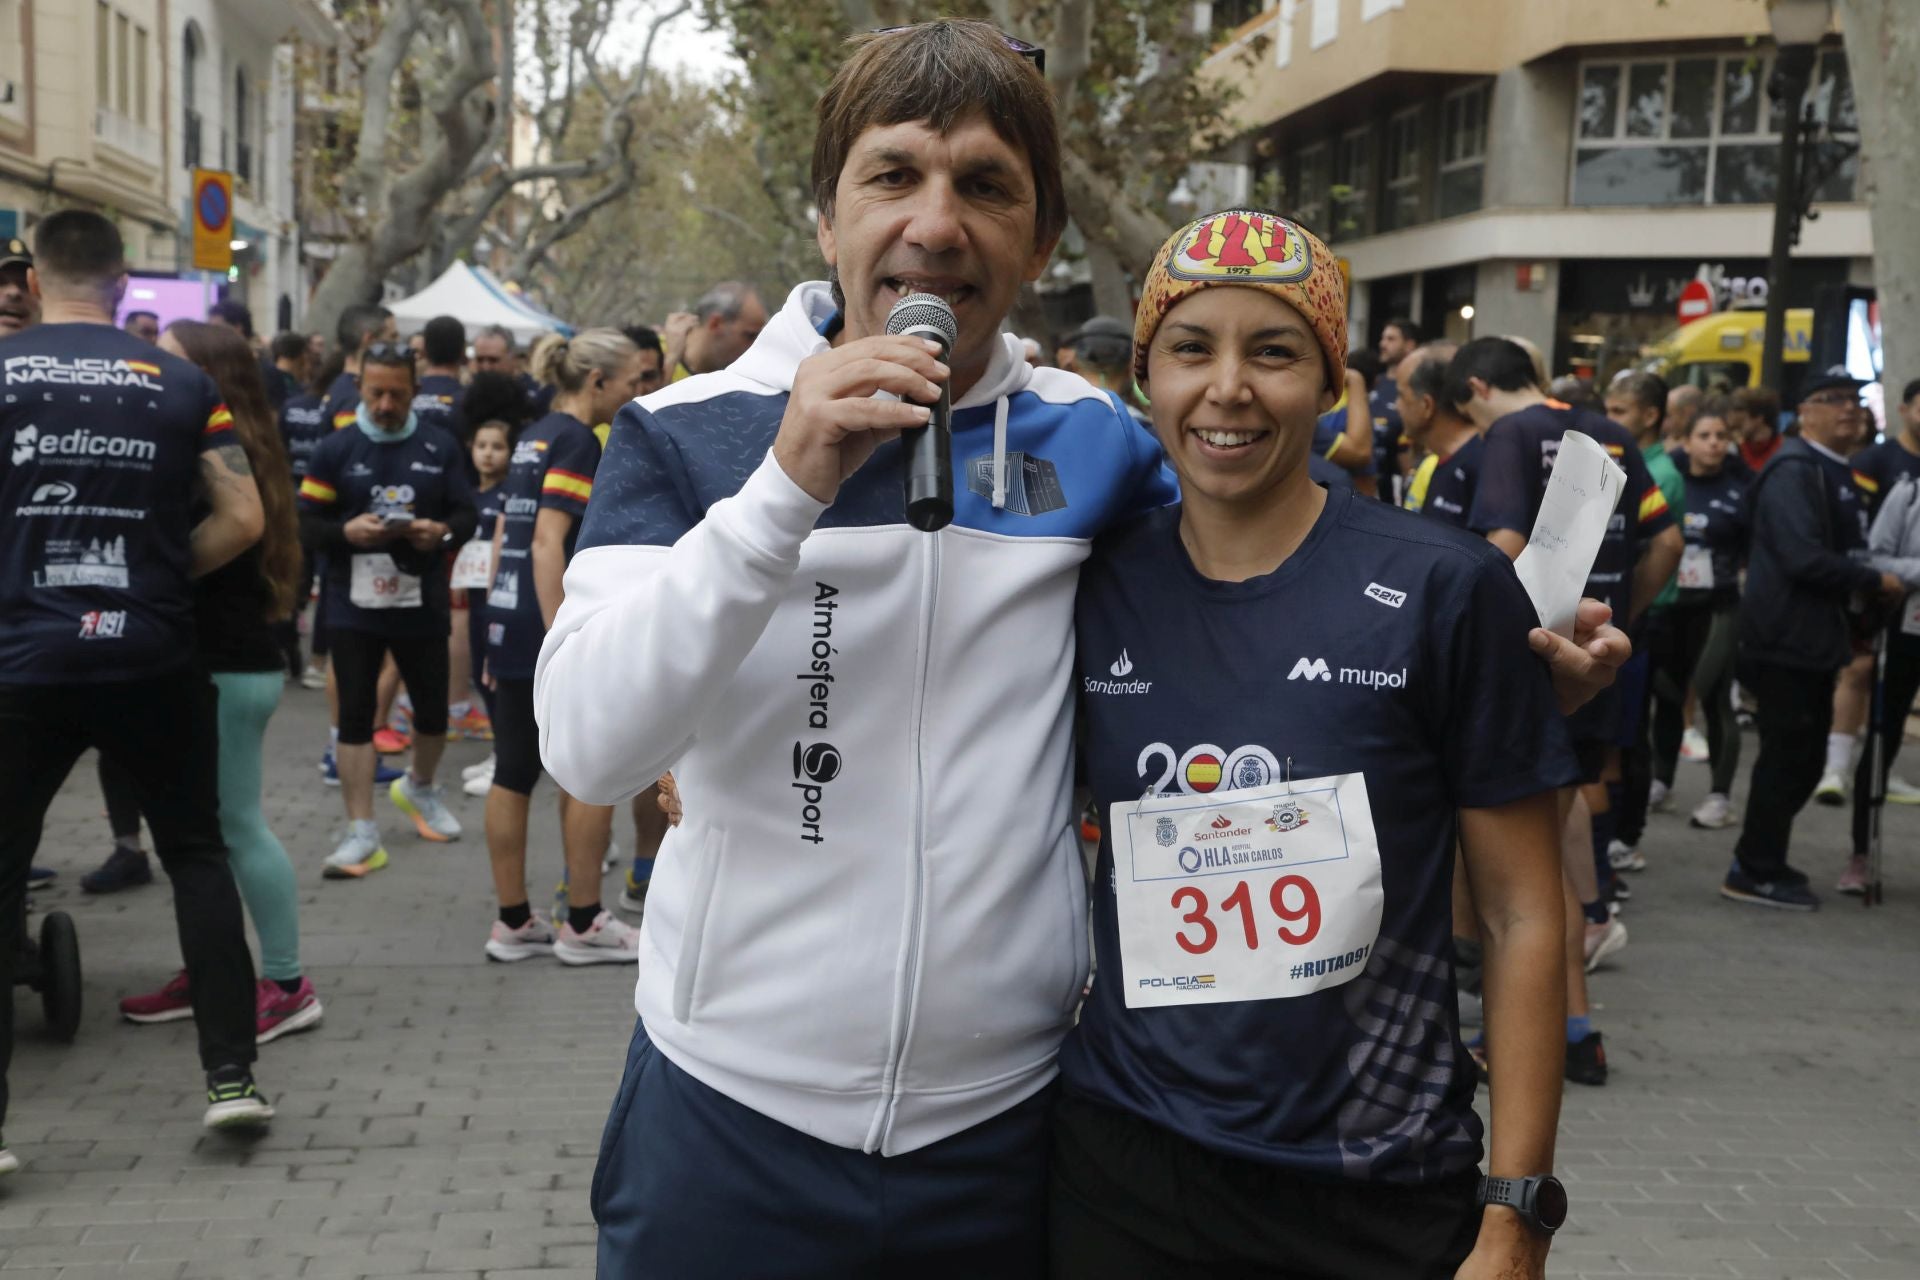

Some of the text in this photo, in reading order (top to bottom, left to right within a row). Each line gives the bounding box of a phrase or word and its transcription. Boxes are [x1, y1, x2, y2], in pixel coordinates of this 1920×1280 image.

[1226, 267, 1252, 275] 1975
[4, 355, 132, 372] POLICIA
[5, 368, 164, 391] NACIONAL
[38, 428, 157, 460] edicom
[15, 505, 146, 520] POWER ELECTRONICS
[1368, 587, 1404, 605] 42K
[796, 581, 840, 729] Atmósfera
[1084, 676, 1153, 695] Santander
[1339, 667, 1407, 691] mupol
[1136, 742, 1281, 800] 200
[1273, 800, 1297, 810] mupol
[1194, 827, 1253, 842] Santander
[1203, 846, 1232, 868] HLA
[1232, 847, 1284, 865] SAN CARLOS
[1170, 874, 1322, 955] 319
[1289, 943, 1371, 980] #RUTA091
[1139, 974, 1201, 988] POLICIA
